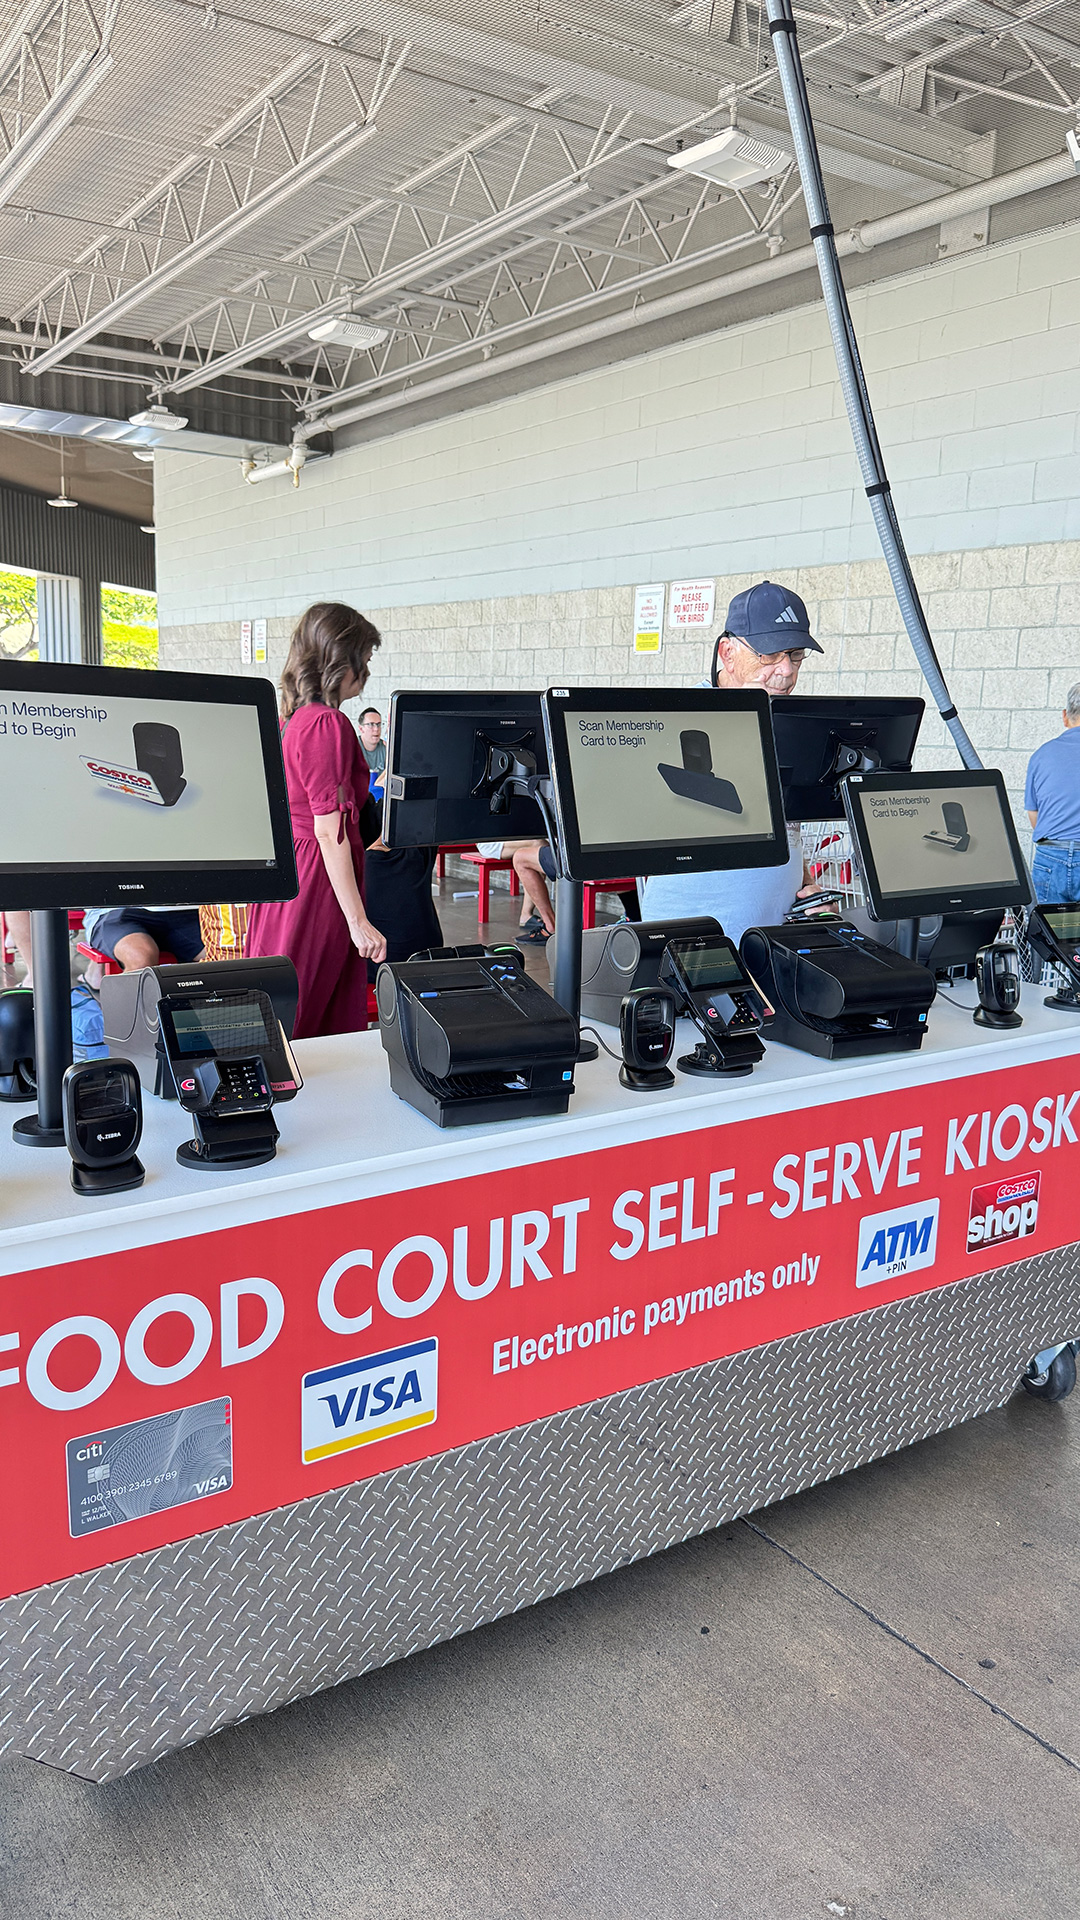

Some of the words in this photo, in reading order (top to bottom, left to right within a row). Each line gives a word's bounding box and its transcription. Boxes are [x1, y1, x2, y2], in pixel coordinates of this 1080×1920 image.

[674, 604, 681, 613] DO
[683, 603, 693, 613] NOT
[694, 602, 709, 612] FEED
[681, 593, 702, 603] PLEASE
[677, 614, 686, 623] THE
[688, 613, 705, 623] BIRDS
[12, 702, 108, 723] Membership
[12, 721, 28, 735] to
[32, 722, 77, 740] Begin
[578, 720, 604, 731] Scan
[606, 720, 664, 733] Membership
[581, 735, 604, 746] Card
[607, 735, 617, 746] to
[619, 735, 646, 748] Begin
[86, 762, 152, 786] COSTCO
[869, 797, 888, 806] Scan
[889, 795, 931, 806] Membership
[872, 808, 889, 818] Card
[891, 809, 898, 817] to
[900, 808, 918, 818] Begin
[177, 980, 204, 988] TOSHIBA
[997, 1179, 1037, 1197] COSTCO
[317, 1198, 590, 1334] COURT
[945, 1090, 1080, 1175] KIOSK
[967, 1200, 1038, 1243] shop
[861, 1215, 934, 1271] ATM
[492, 1306, 636, 1375] Electronic
[643, 1268, 765, 1336] payments
[772, 1252, 821, 1290] only
[318, 1369, 423, 1428] VISA
[76, 1441, 103, 1461] citi
[80, 1492, 104, 1506] 4100
[105, 1486, 127, 1499] 3901
[129, 1478, 151, 1492] 2345
[154, 1470, 178, 1484] 6789
[192, 1475, 228, 1495] VISA
